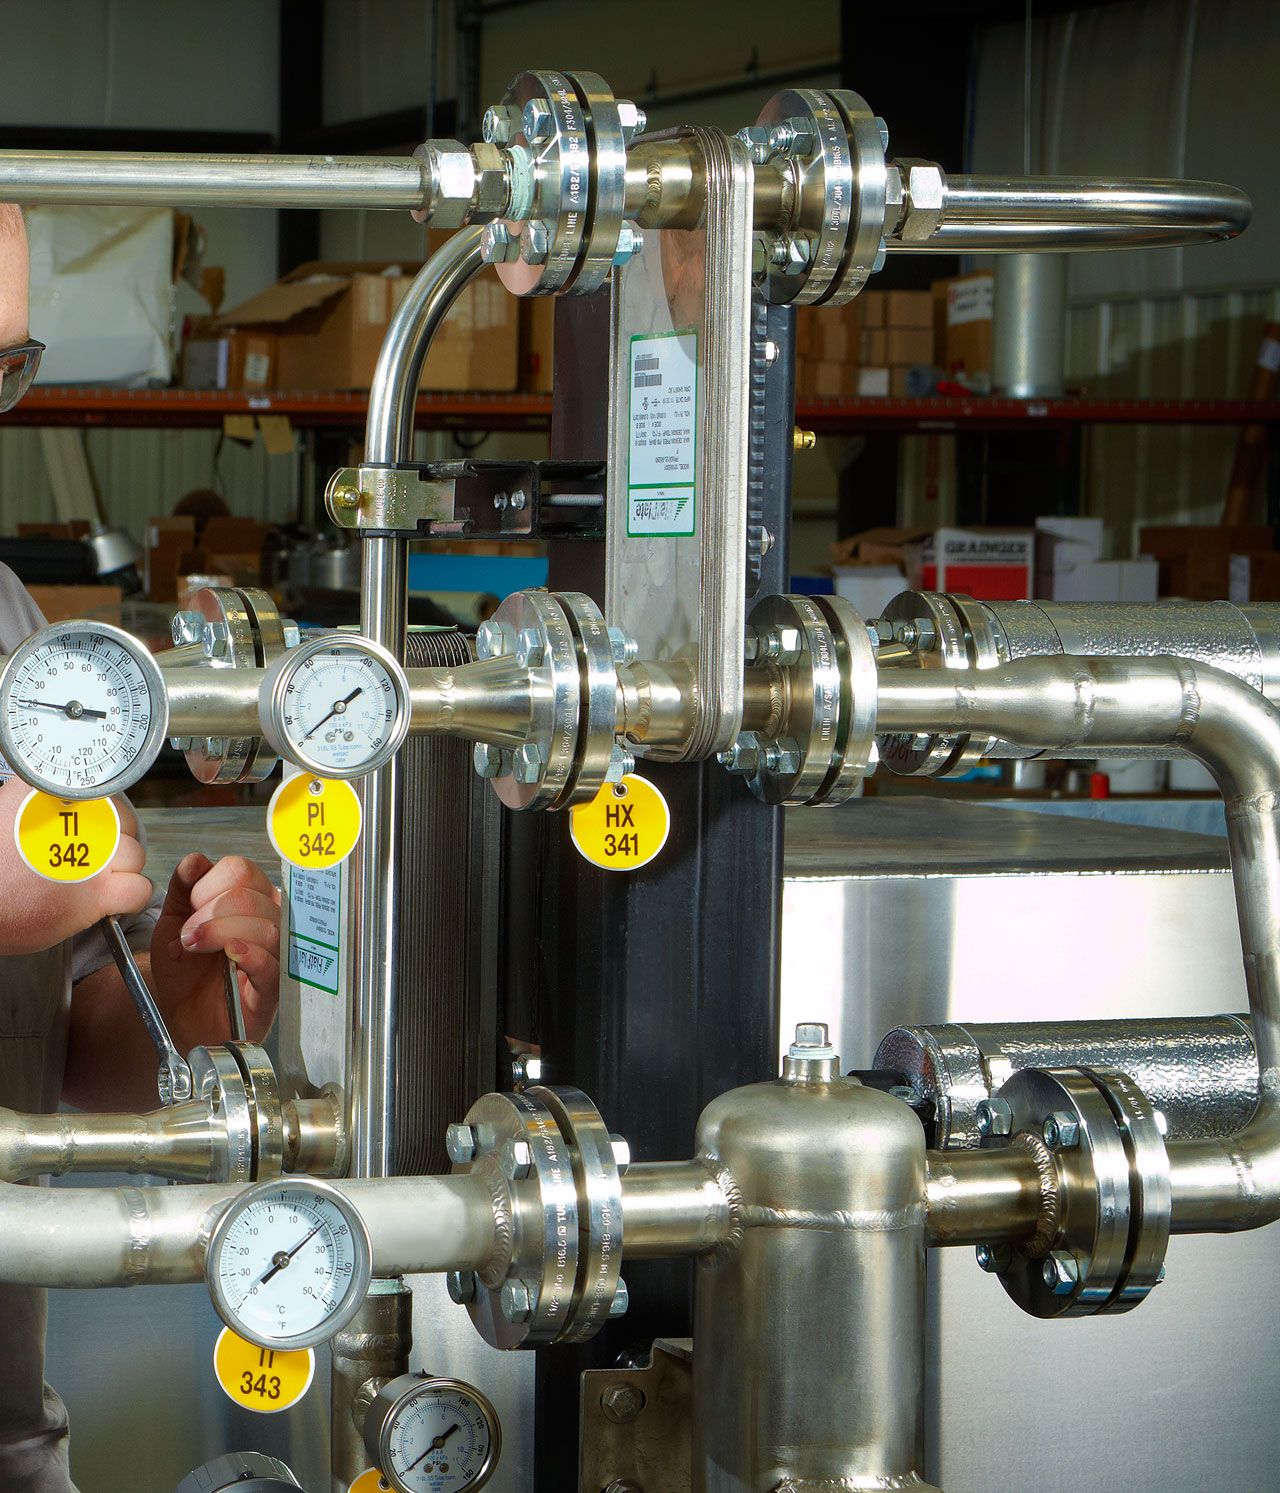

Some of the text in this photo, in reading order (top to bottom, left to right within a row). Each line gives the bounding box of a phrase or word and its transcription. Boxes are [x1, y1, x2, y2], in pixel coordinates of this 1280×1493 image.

[565, 212, 578, 235] LINE
[89, 635, 104, 646] 140
[119, 652, 132, 665] 160
[64, 662, 74, 670] 50
[81, 664, 92, 673] 60
[304, 660, 314, 669] 60
[47, 667, 57, 676] 40
[97, 673, 107, 682] 70
[35, 681, 45, 690] 30
[137, 680, 147, 695] 180
[287, 684, 295, 695] 40
[380, 678, 391, 692] 120
[107, 688, 117, 697] 80
[28, 699, 38, 708] 20
[110, 706, 120, 715] 90
[385, 709, 393, 722] 140
[28, 718, 38, 726] 10
[138, 715, 149, 731] 200
[285, 715, 293, 726] 20
[101, 724, 116, 733] 100
[37, 734, 43, 743] 0
[92, 738, 107, 747] 110
[370, 737, 383, 750] 160
[48, 745, 62, 754] -10
[78, 747, 93, 756] 120
[123, 746, 137, 762] 220
[71, 755, 81, 766] °C
[66, 777, 72, 786] 0
[80, 776, 96, 787] 250
[307, 803, 325, 826] PI
[606, 804, 634, 828] HX
[59, 812, 78, 836] TI
[299, 833, 336, 858] 342
[604, 833, 639, 857] 341
[49, 843, 90, 868] 342
[295, 950, 323, 974] FlatPlat
[314, 1195, 325, 1205] 60
[268, 1216, 274, 1224] 0
[288, 1216, 298, 1224] 10
[246, 1227, 258, 1236] -10
[338, 1224, 349, 1236] 80
[237, 1247, 250, 1256] -20
[315, 1245, 325, 1254] 30
[238, 1268, 251, 1276] -30
[314, 1267, 324, 1275] 40
[343, 1262, 353, 1278] 100
[246, 1287, 258, 1296] -40
[303, 1286, 313, 1295] 50
[276, 1304, 285, 1314] °C
[323, 1299, 337, 1314] 120
[278, 1321, 286, 1330] °F
[239, 1371, 281, 1400] 343
[409, 1400, 418, 1408] 60
[458, 1397, 470, 1407] 100
[393, 1420, 400, 1430] 40
[475, 1416, 485, 1430] 120
[390, 1449, 396, 1458] 20
[477, 1445, 485, 1457] 140
[463, 1469, 474, 1481] 160
